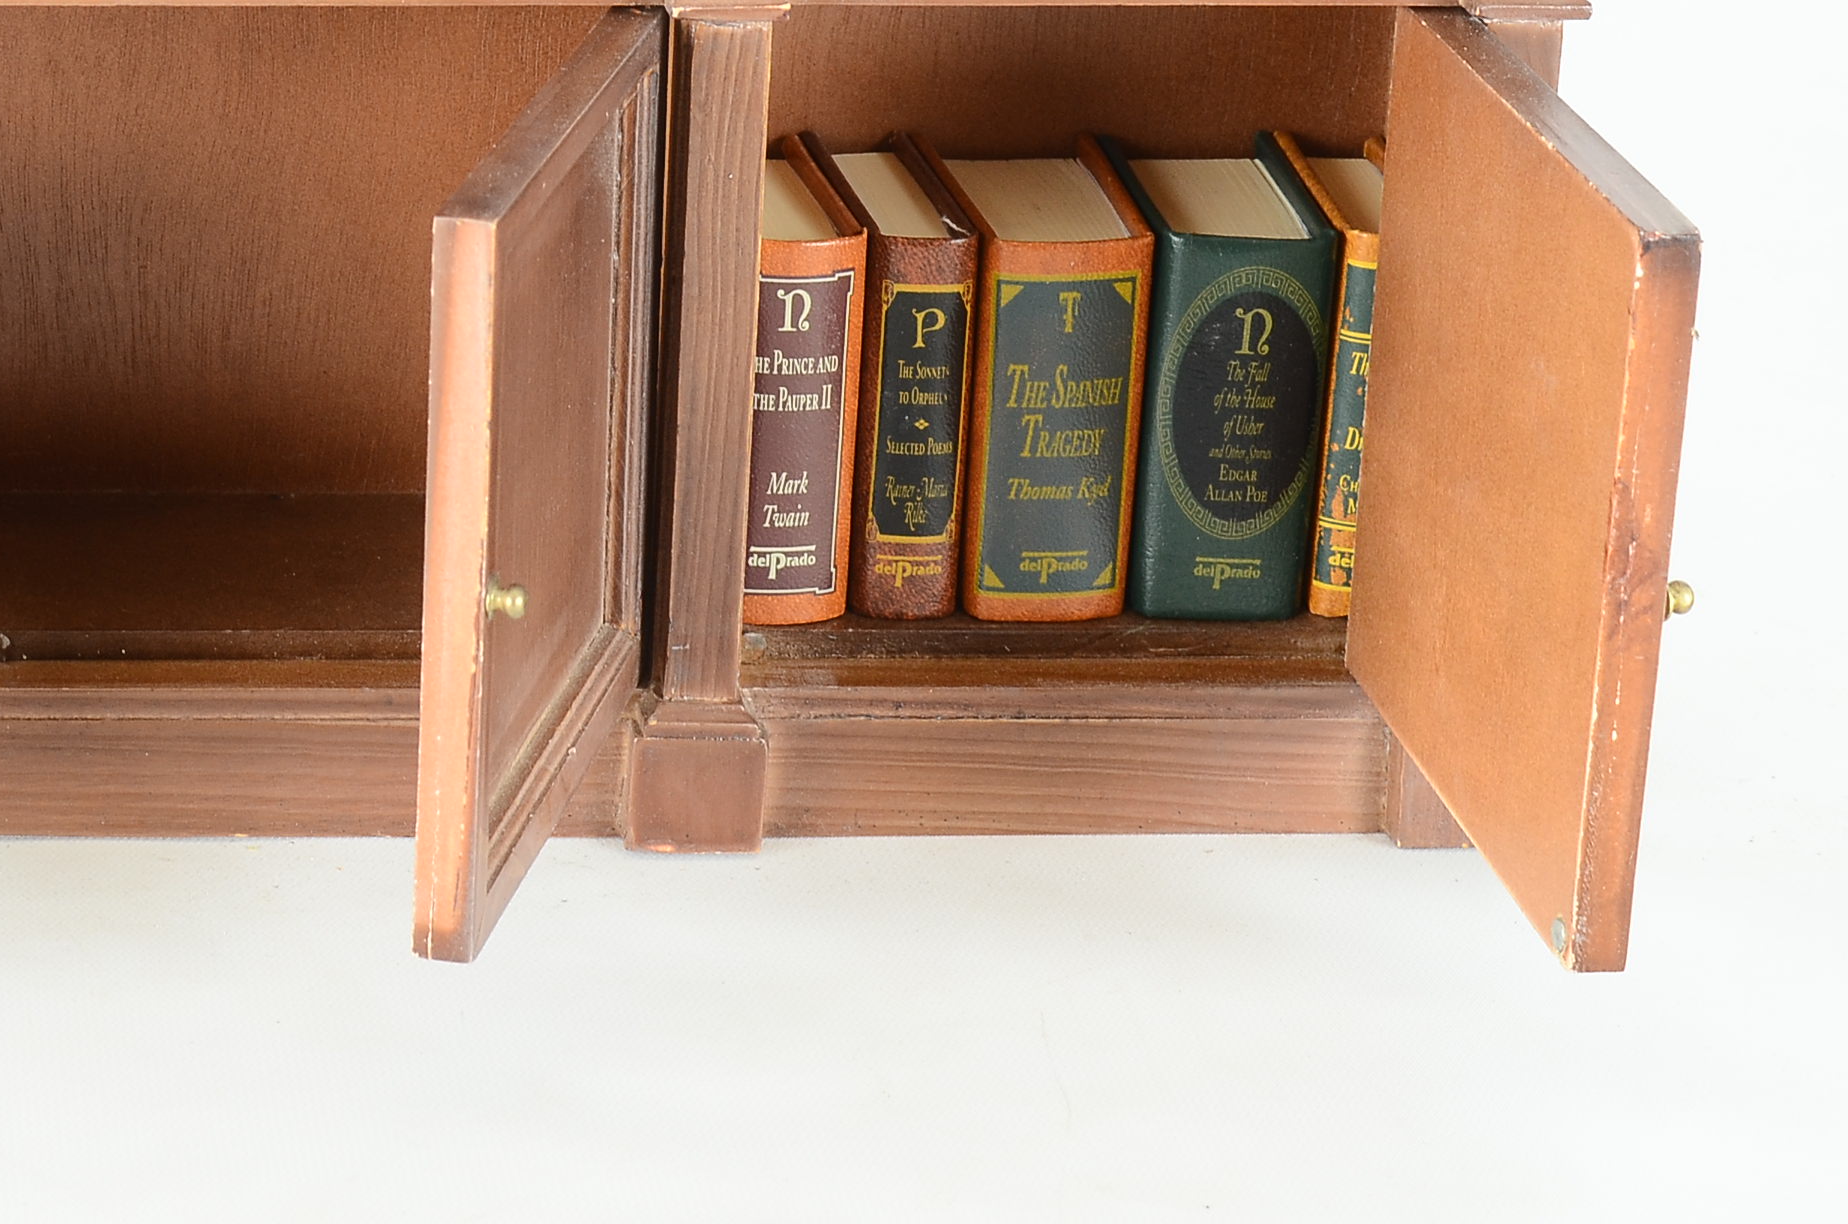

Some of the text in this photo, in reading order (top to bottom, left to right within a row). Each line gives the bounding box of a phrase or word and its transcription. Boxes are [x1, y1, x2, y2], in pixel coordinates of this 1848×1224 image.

[1006, 365, 1047, 410] THE
[766, 472, 808, 496] Mark
[1007, 479, 1072, 501] Thomas
[763, 503, 809, 528] Twain
